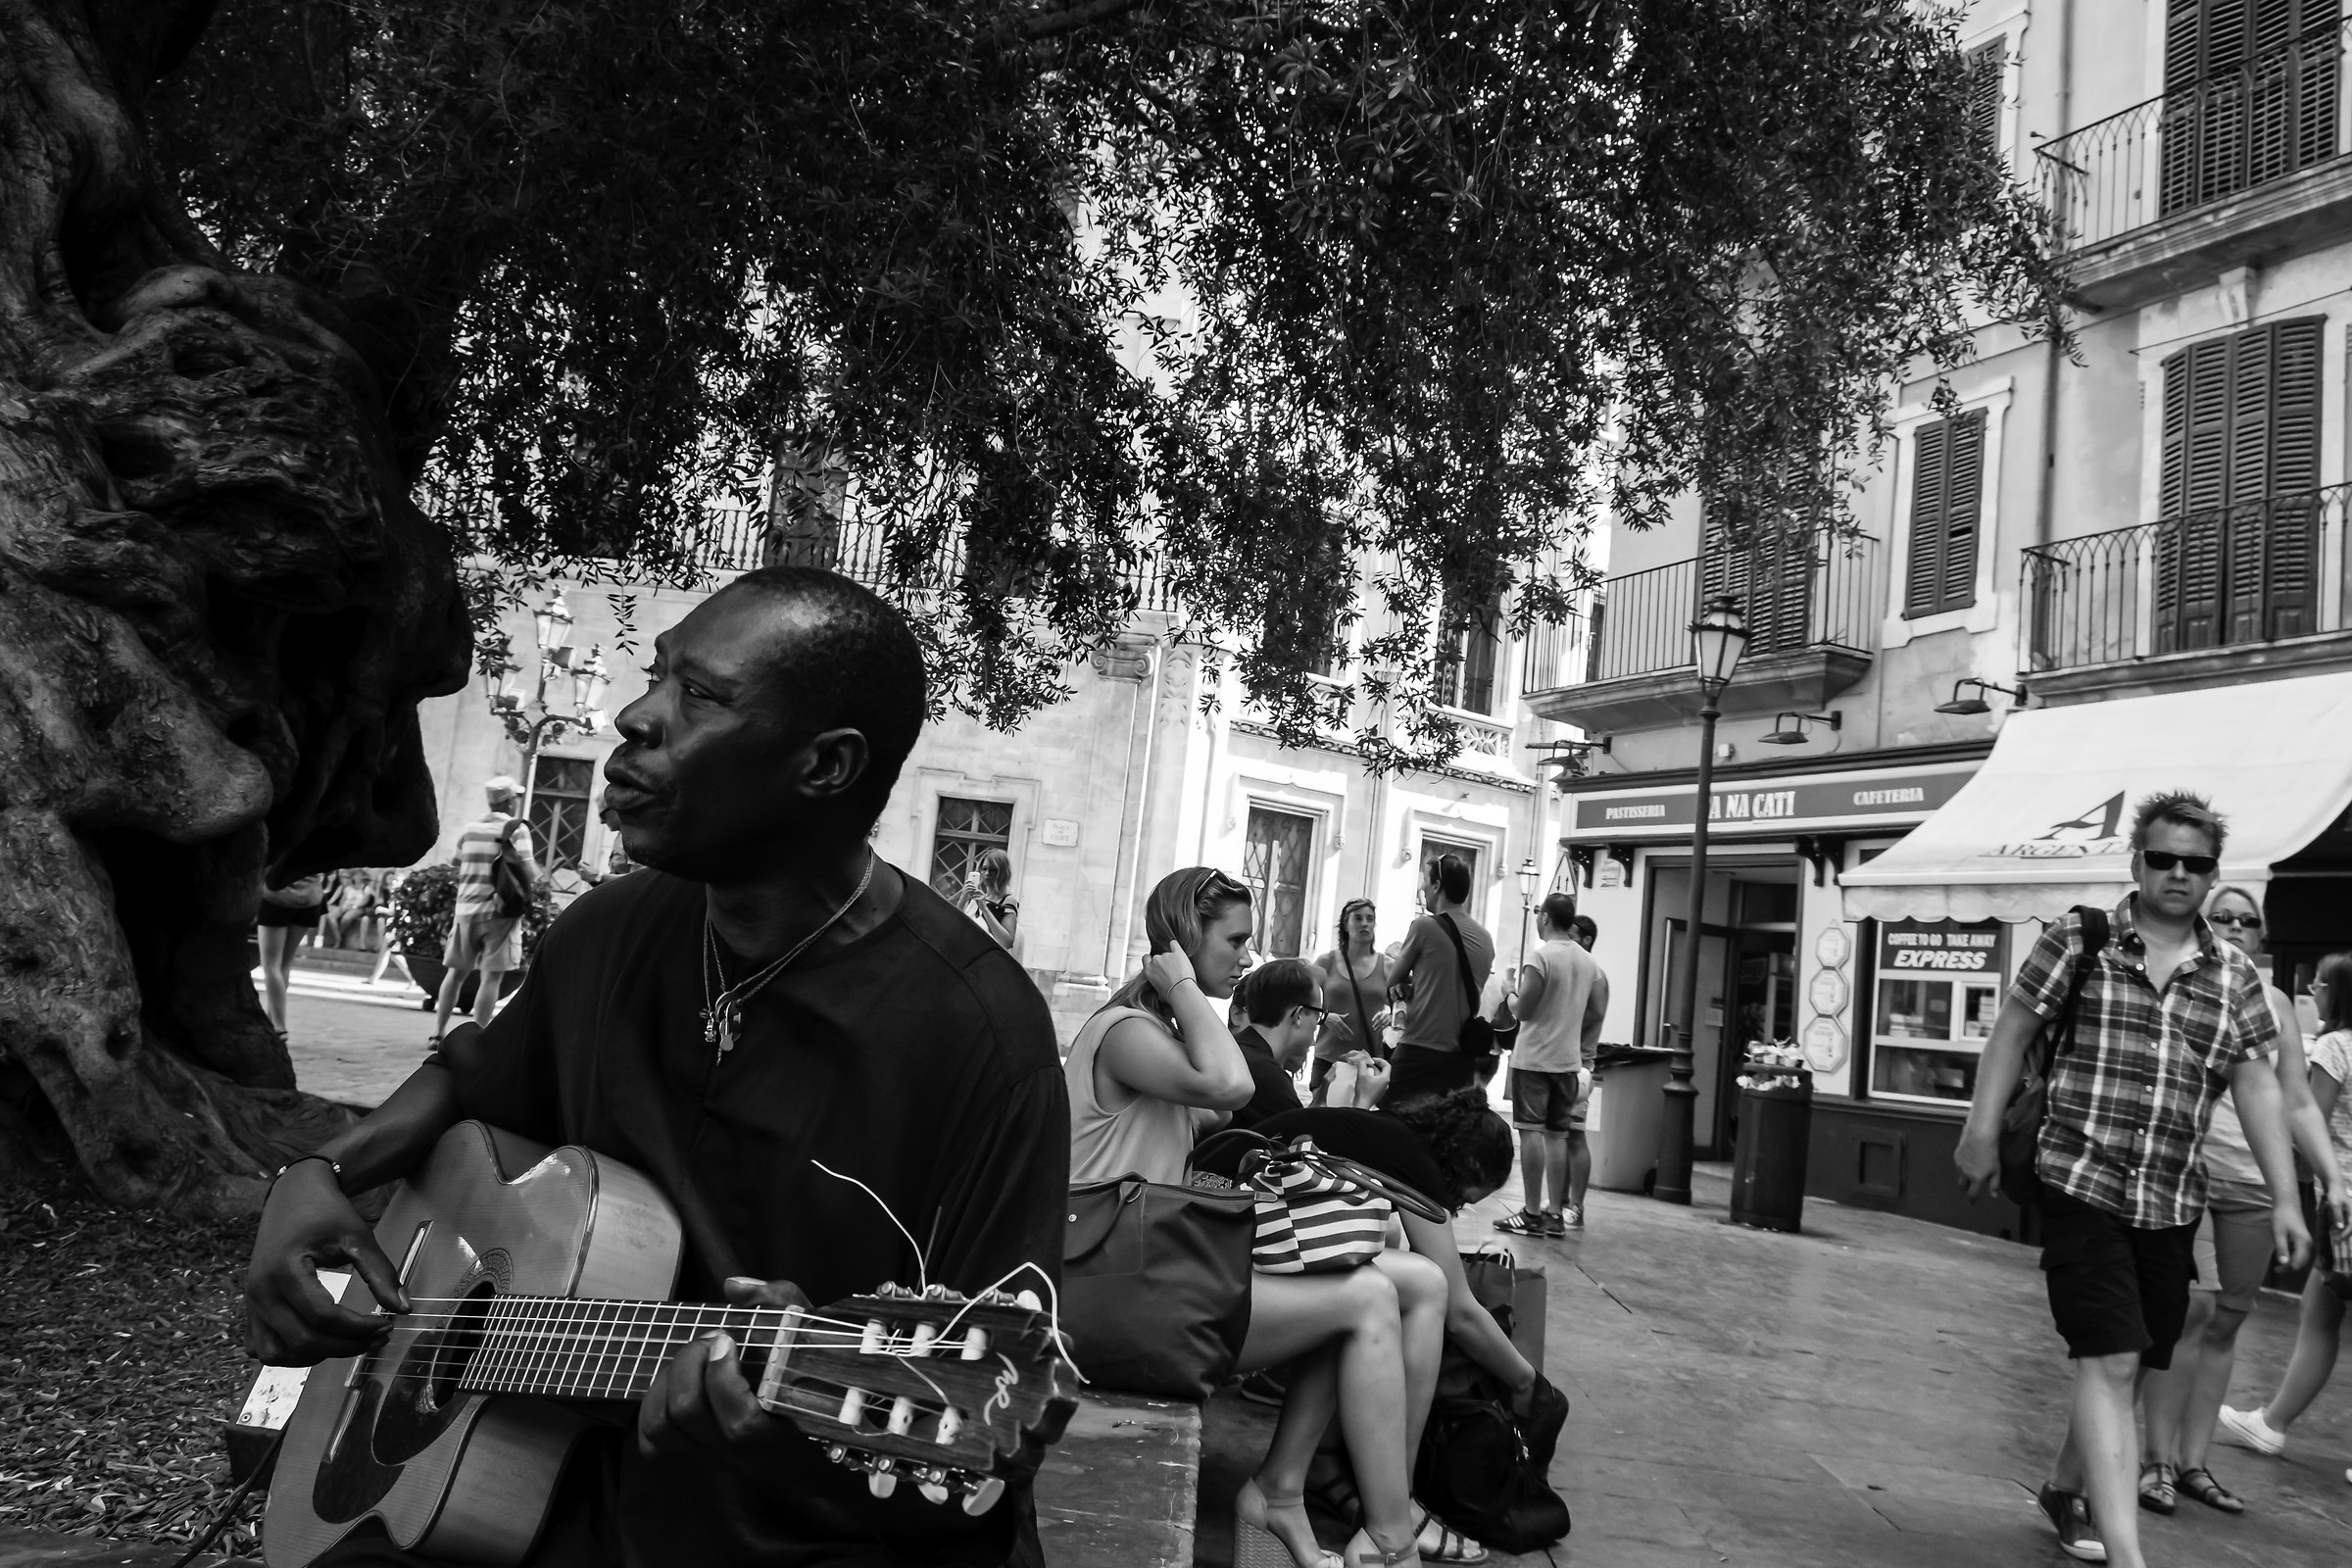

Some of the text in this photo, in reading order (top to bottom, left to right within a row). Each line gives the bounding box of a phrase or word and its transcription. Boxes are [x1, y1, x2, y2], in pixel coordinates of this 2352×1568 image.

[1725, 794, 1750, 818] NA
[1752, 791, 1796, 818] CATI
[1853, 787, 1924, 806] CAFETERIA
[1605, 805, 1665, 819] PASTISSERIA
[1887, 933, 1996, 948] COFFEE TO GO TAKE AWAY
[1893, 950, 1987, 969] EXPRESS
